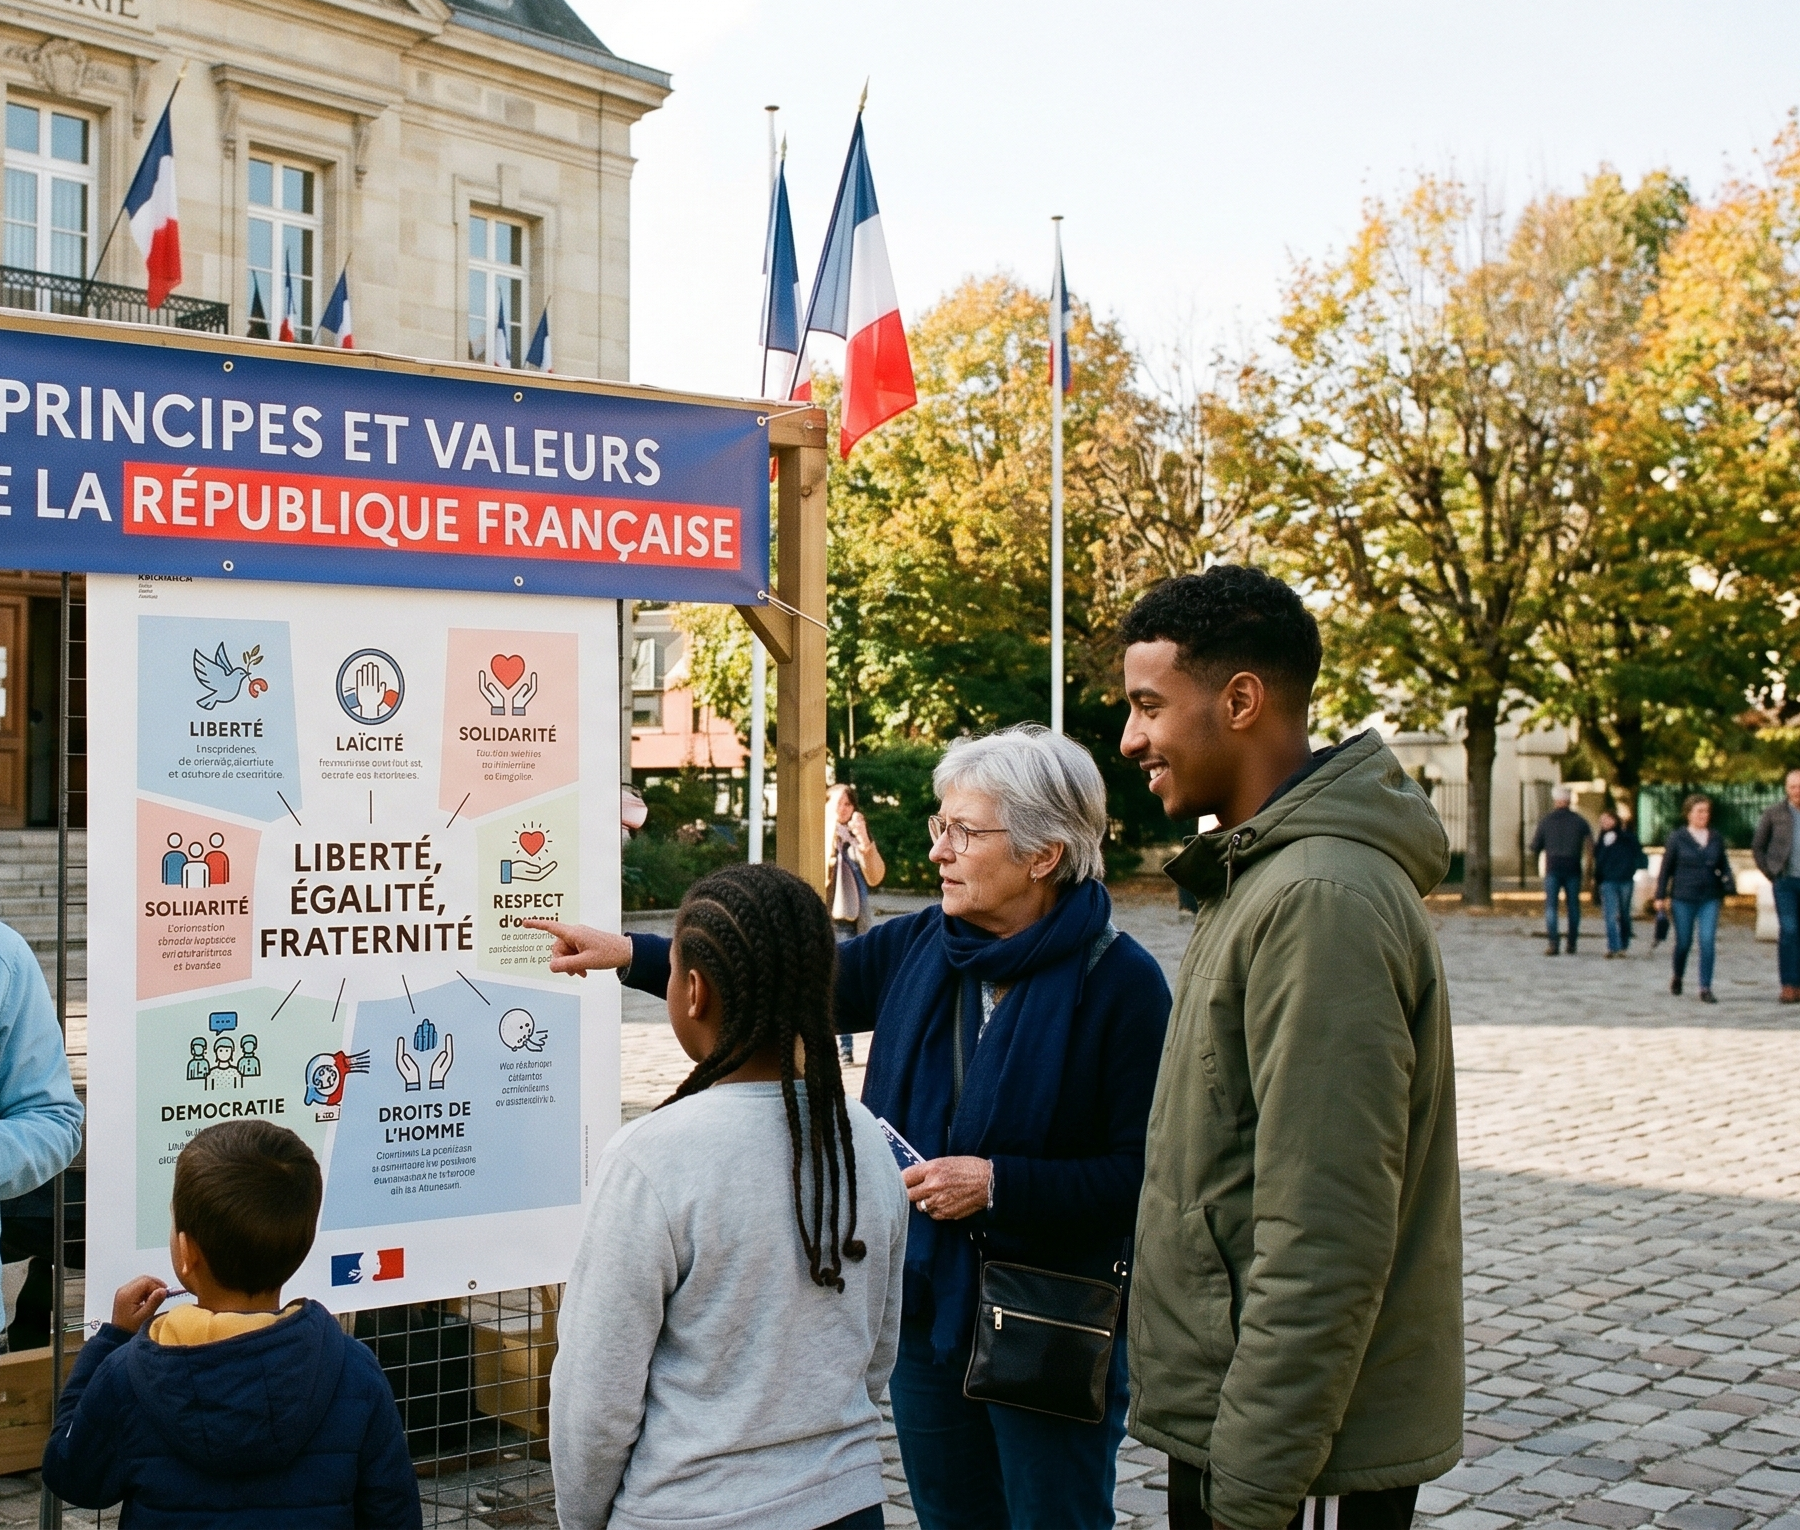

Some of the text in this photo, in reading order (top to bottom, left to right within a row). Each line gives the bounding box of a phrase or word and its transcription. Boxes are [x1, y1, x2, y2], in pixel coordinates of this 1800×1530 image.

[0, 378, 661, 487] PRINCIPES ET VALEURS
[37, 468, 113, 522] LA
[133, 467, 459, 548] RÉPUBLIQUE
[478, 501, 734, 562] FRANÇAISE
[190, 718, 263, 737] LIBERTÉ
[459, 725, 557, 742] SOLIDARITÉ
[336, 732, 404, 751] LAÏCITÉ
[294, 834, 442, 875] LIBERTÉ,
[291, 875, 446, 916] ÉGALITÉ,
[493, 893, 564, 909] RESPECT
[260, 915, 473, 958] FRATERNITÉ
[161, 1098, 285, 1121] DEMOCRATIE
[379, 1101, 471, 1122] DROITS DE
[385, 1122, 465, 1143] L'HOMME
